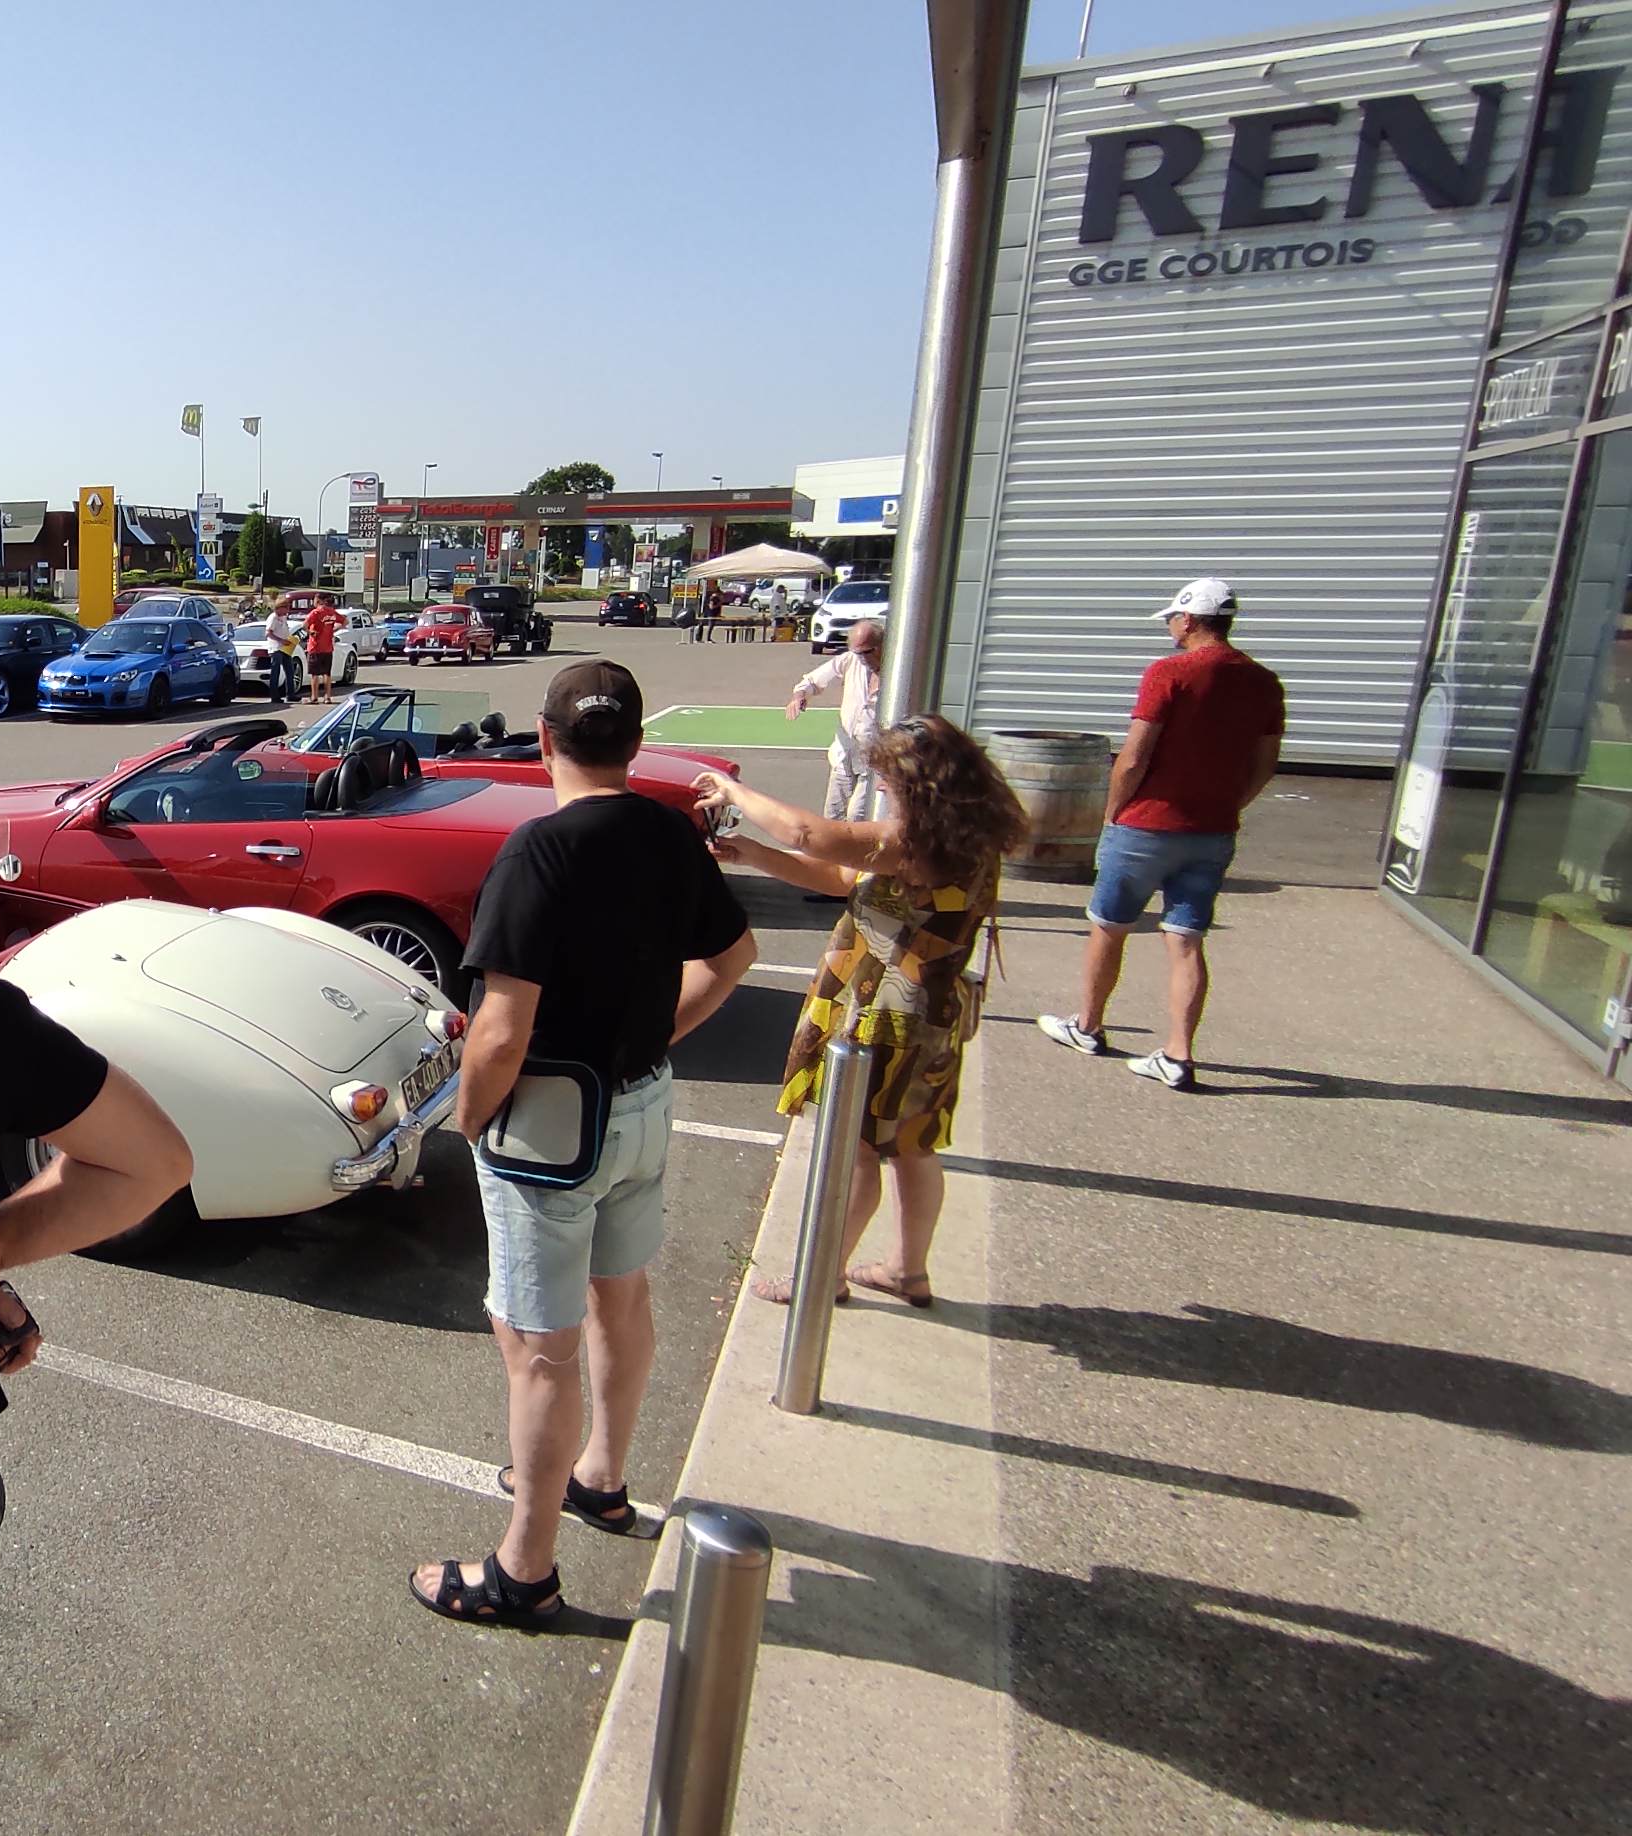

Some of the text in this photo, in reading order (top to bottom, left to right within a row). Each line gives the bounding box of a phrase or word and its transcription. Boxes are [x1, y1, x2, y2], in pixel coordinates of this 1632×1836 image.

[1078, 80, 1520, 244] REN
[1069, 238, 1375, 287] GGE COURTOIS
[419, 502, 513, 518] TotalEnergies
[537, 506, 566, 514] CERNAY
